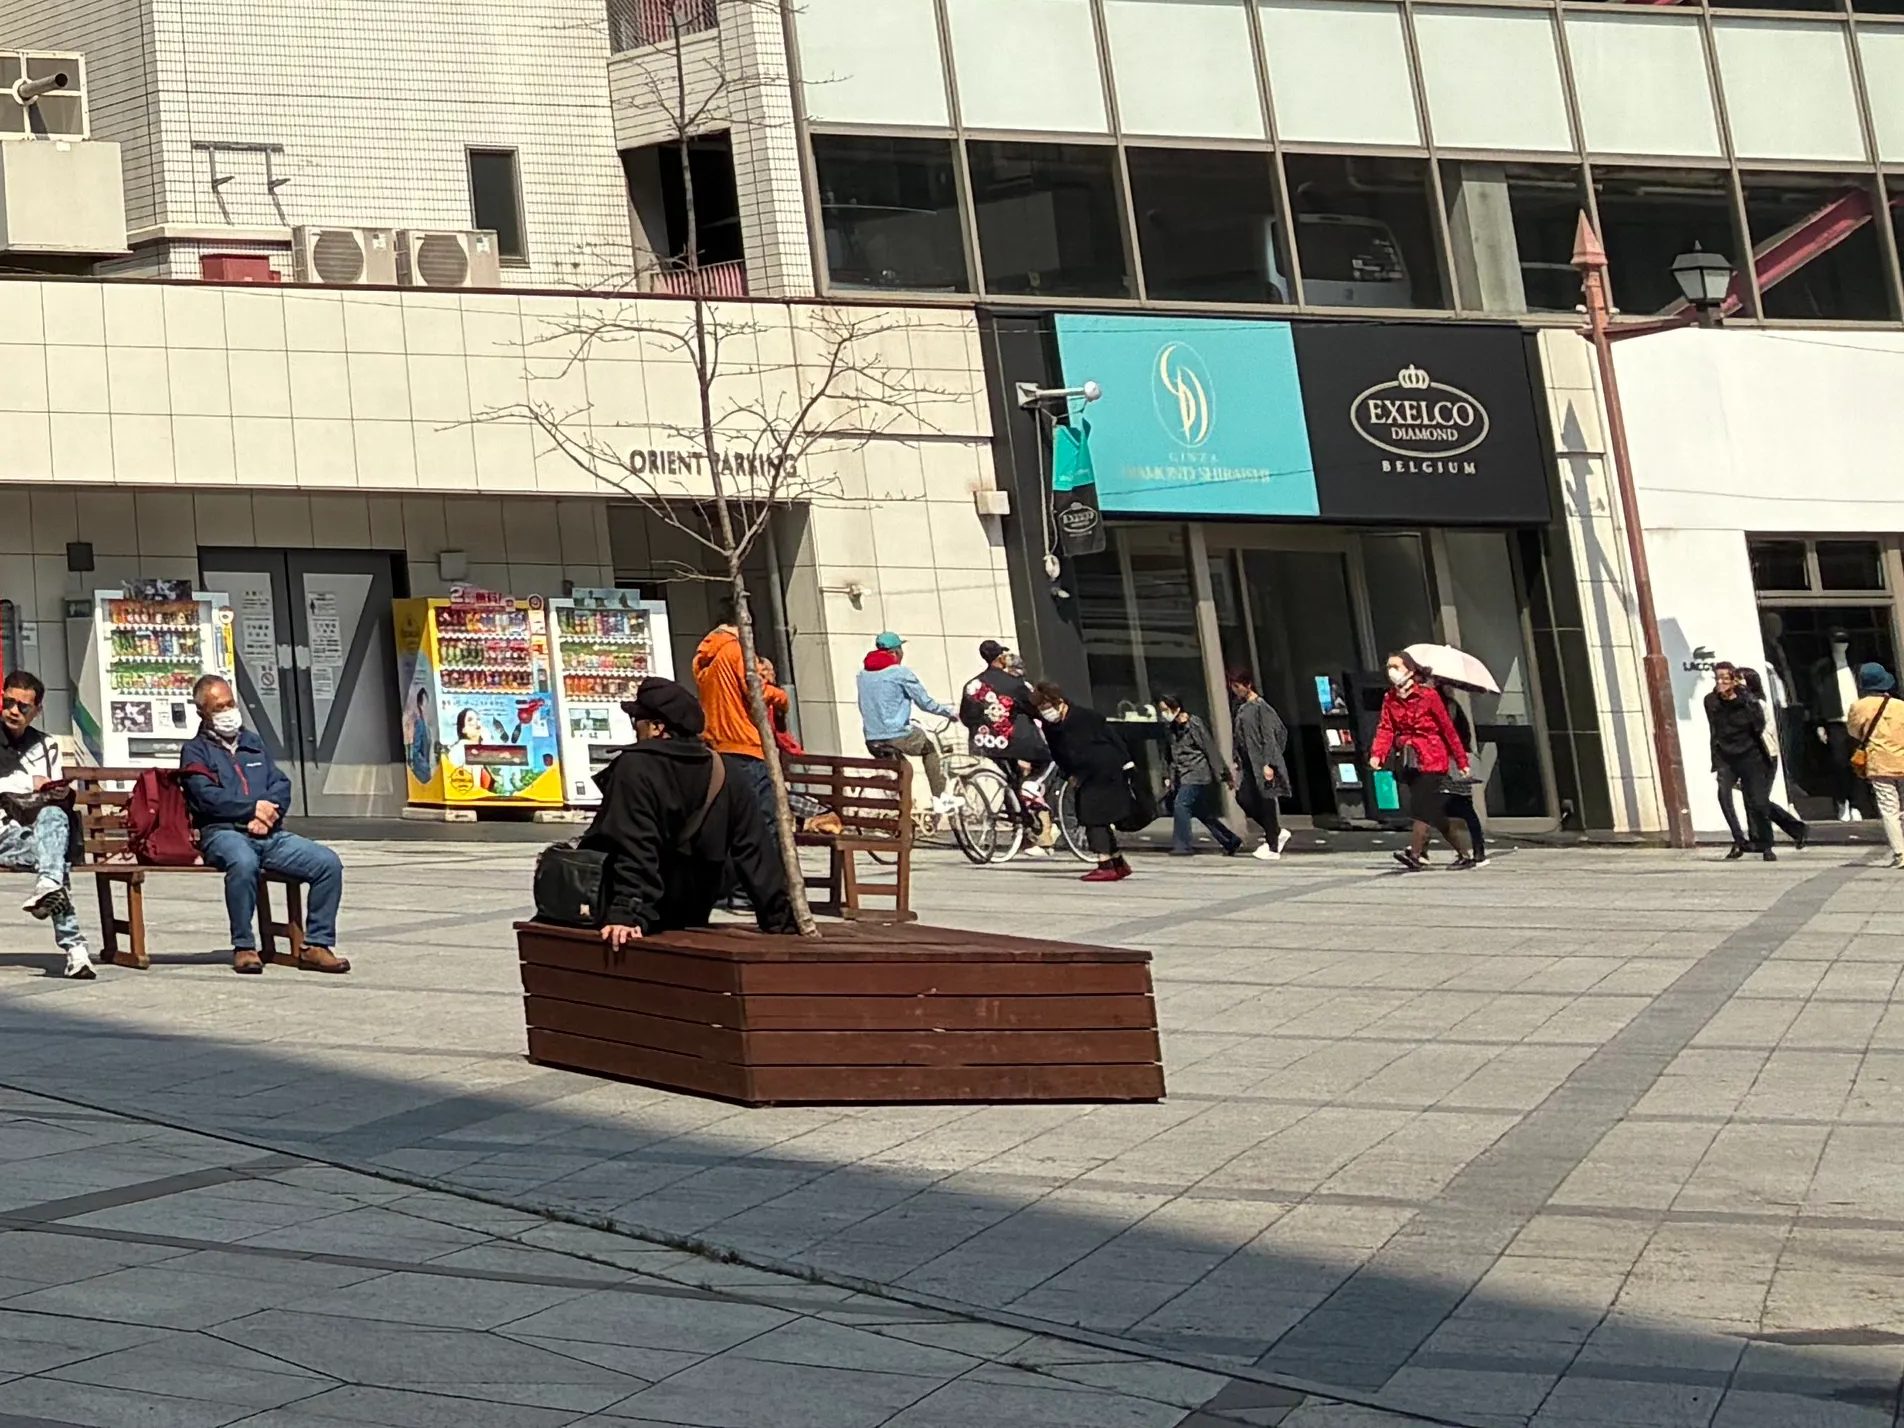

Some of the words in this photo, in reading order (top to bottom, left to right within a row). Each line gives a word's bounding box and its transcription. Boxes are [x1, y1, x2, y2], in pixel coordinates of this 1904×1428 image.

[1368, 399, 1474, 427] EXELCO
[1391, 427, 1458, 441] DIAMOND
[630, 449, 702, 476] ORIENT
[1382, 460, 1476, 474] BELGIUM
